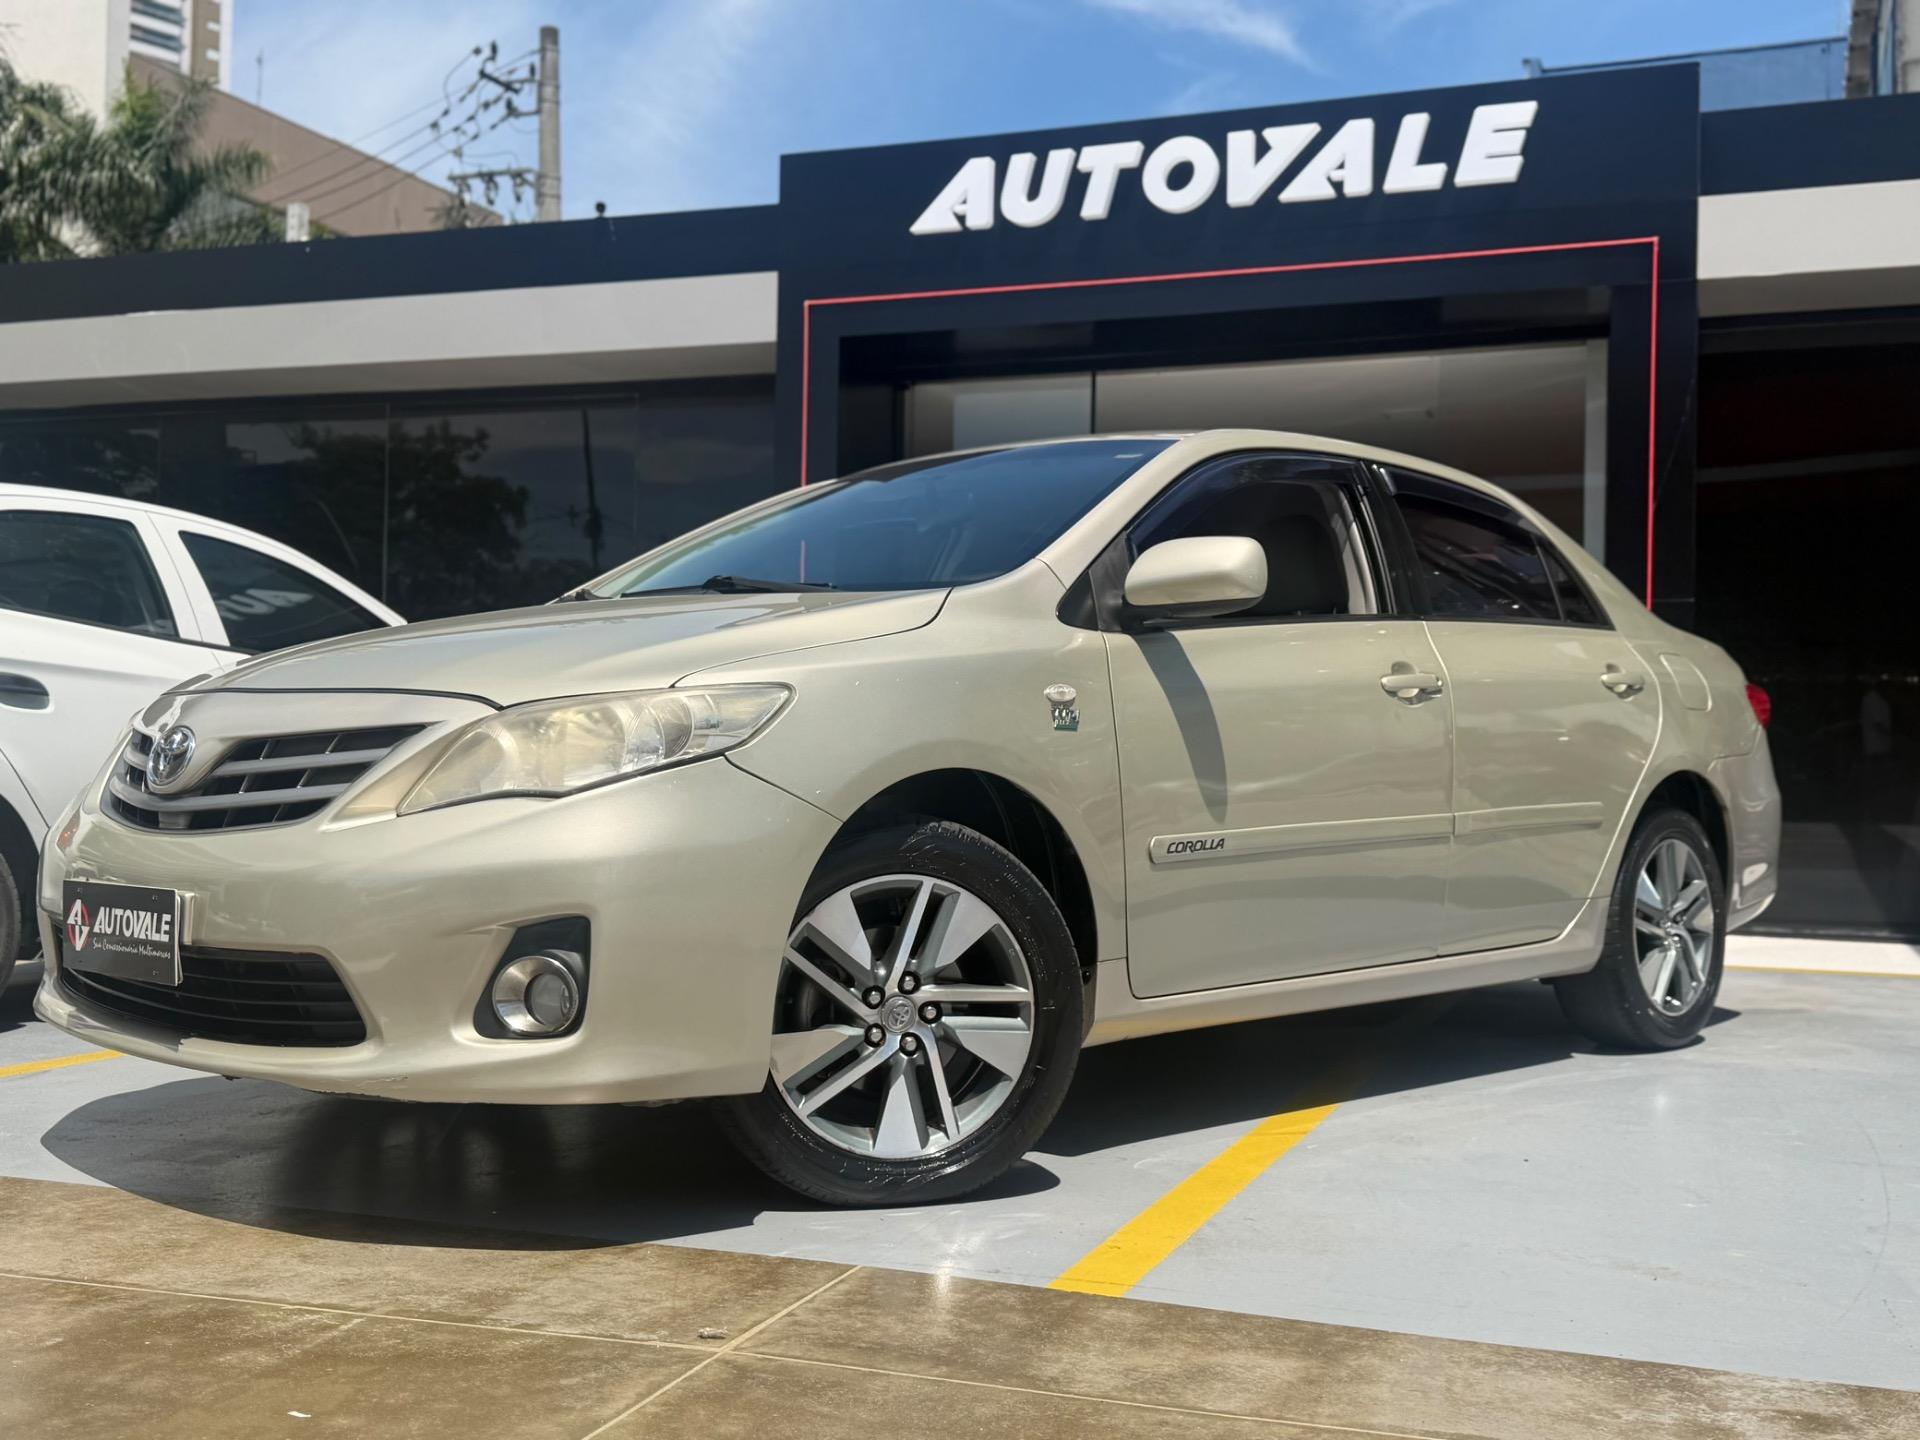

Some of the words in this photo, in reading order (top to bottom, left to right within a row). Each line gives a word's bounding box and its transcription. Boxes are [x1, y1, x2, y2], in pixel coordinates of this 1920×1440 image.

[909, 100, 1538, 235] AUTOVALE
[1167, 838, 1225, 854] COROLLA
[93, 907, 172, 942] AUTOVALE
